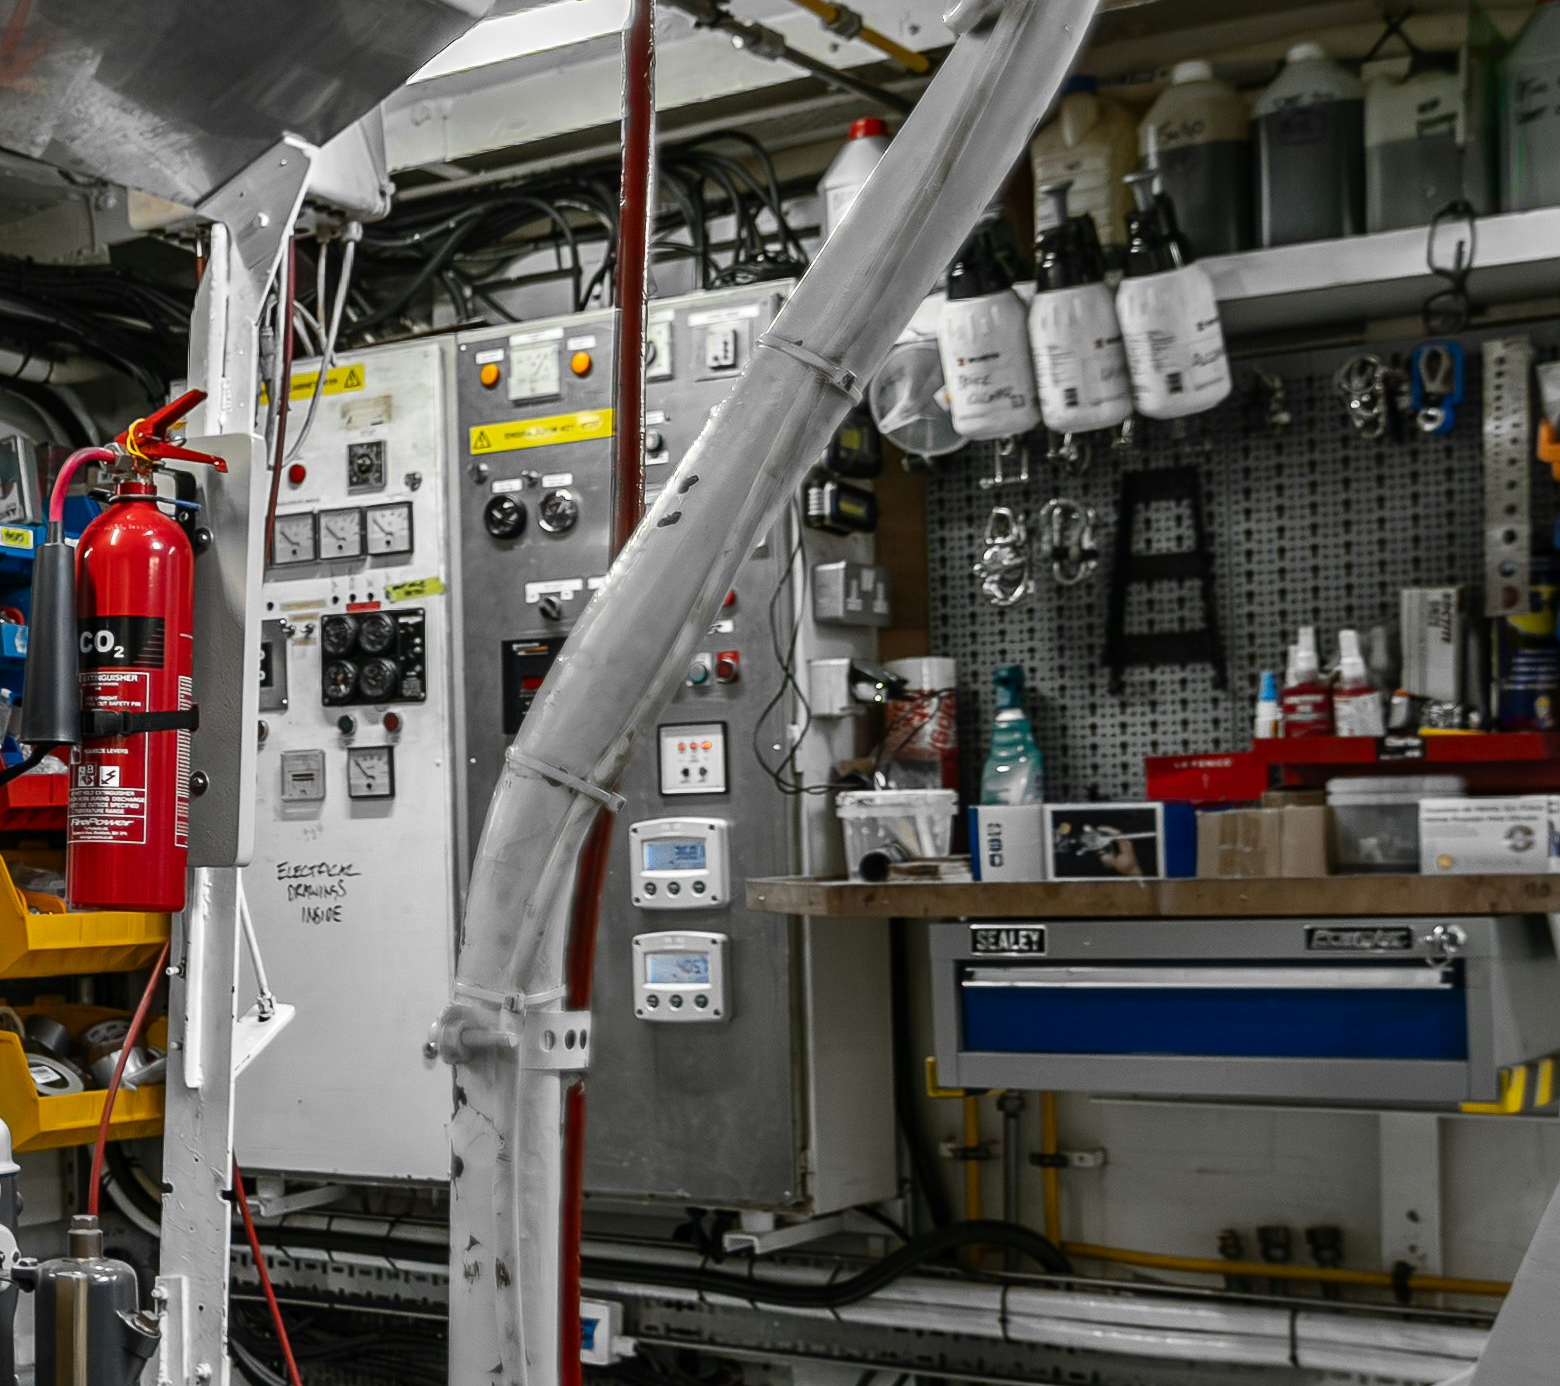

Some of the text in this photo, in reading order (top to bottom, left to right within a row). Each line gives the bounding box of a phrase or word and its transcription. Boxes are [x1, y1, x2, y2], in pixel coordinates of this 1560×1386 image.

[288, 878, 347, 902] DRAWINGS
[301, 904, 342, 924] INSIDE
[975, 930, 1040, 950] SEALEY
